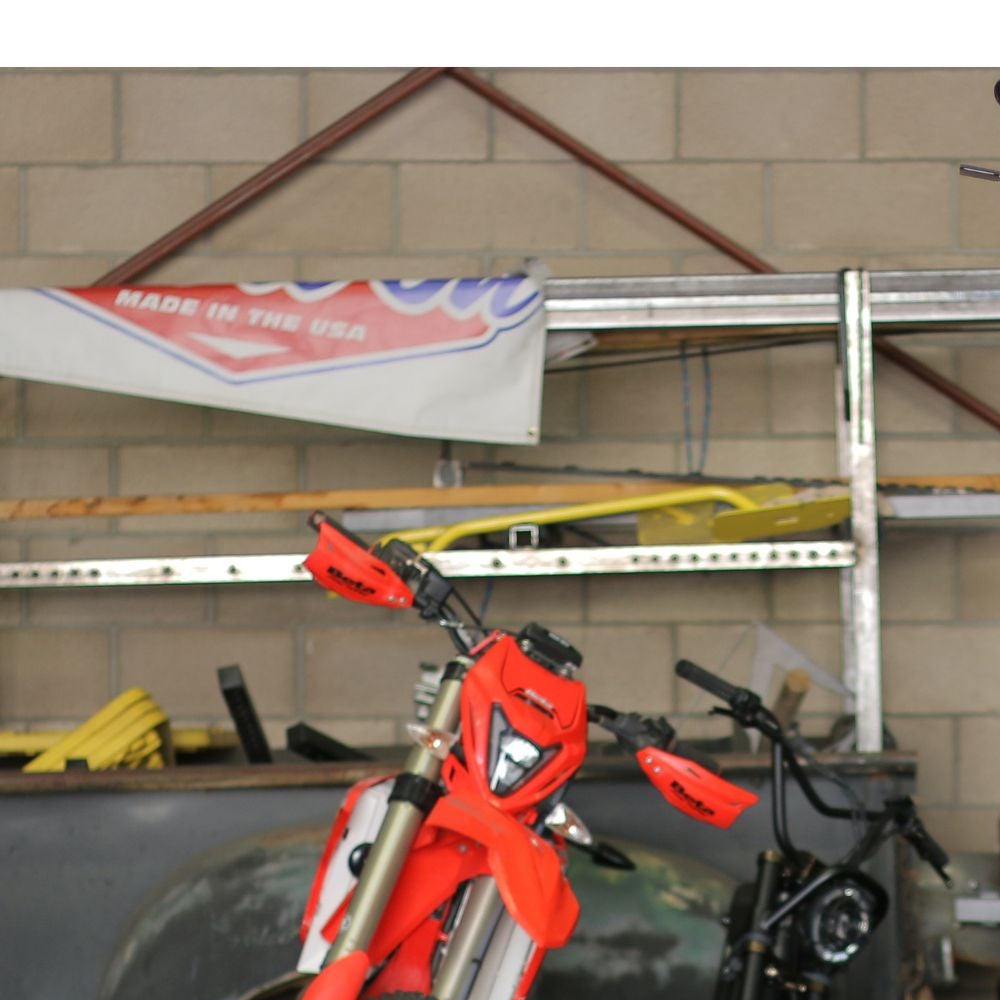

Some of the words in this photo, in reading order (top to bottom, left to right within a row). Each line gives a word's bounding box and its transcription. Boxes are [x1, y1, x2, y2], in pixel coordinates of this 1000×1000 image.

[114, 289, 200, 316] MADE
[205, 302, 240, 321] IN
[248, 308, 301, 332] THE
[308, 318, 367, 341] USA
[327, 566, 376, 595] Beta
[671, 780, 715, 816] Beta
